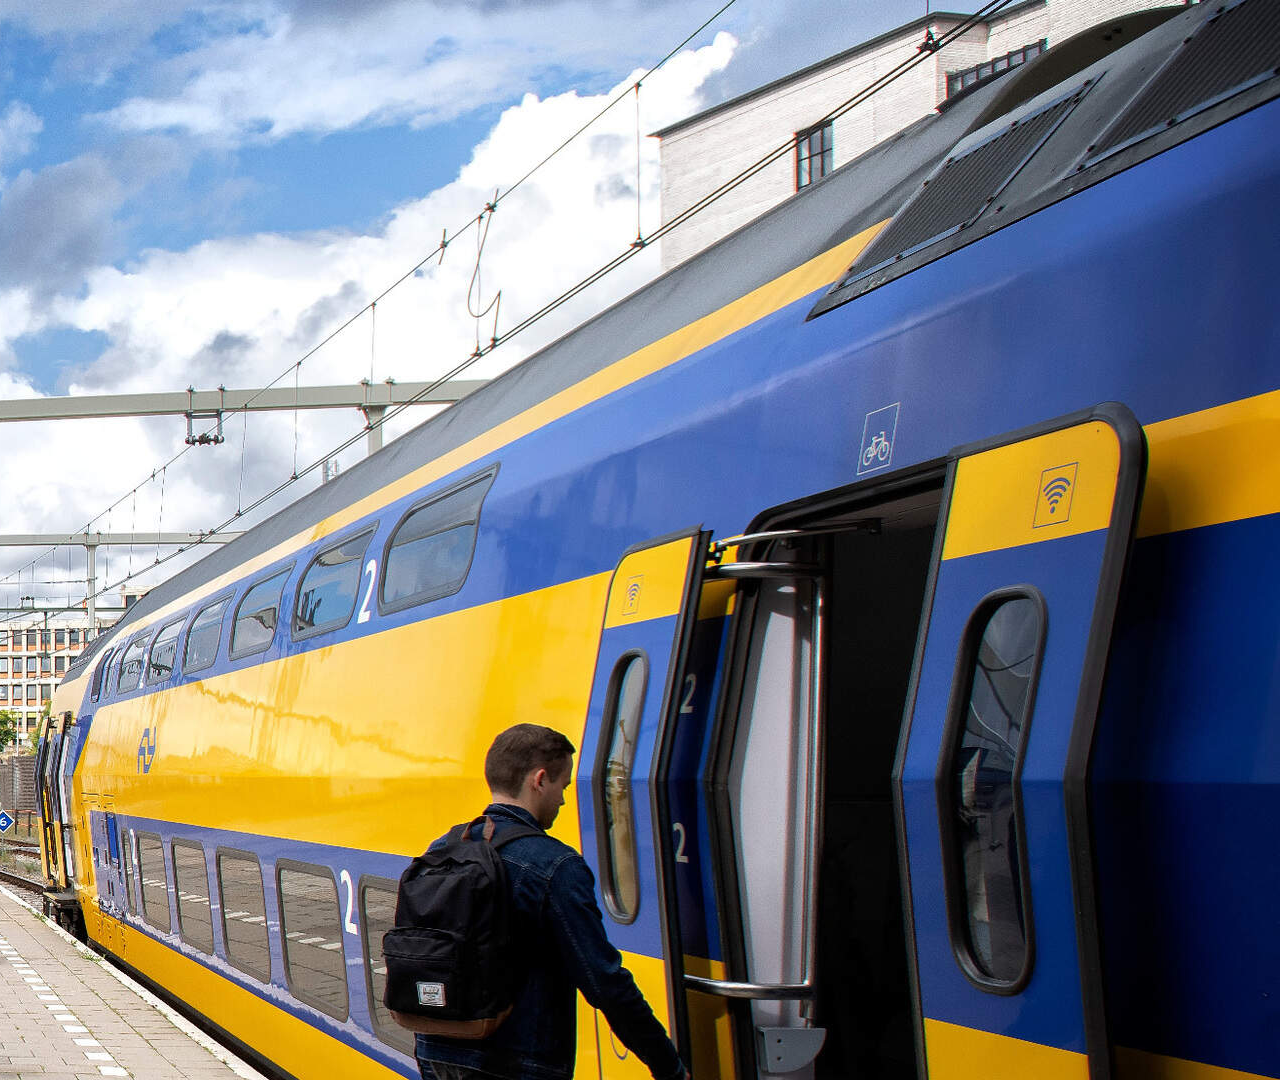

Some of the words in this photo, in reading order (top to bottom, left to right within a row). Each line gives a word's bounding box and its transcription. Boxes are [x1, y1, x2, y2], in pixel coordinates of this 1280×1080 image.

[357, 559, 377, 624] 2
[680, 673, 697, 714] 2
[0, 815, 7, 828] 6
[672, 822, 689, 864] 2
[340, 869, 358, 936] 2
